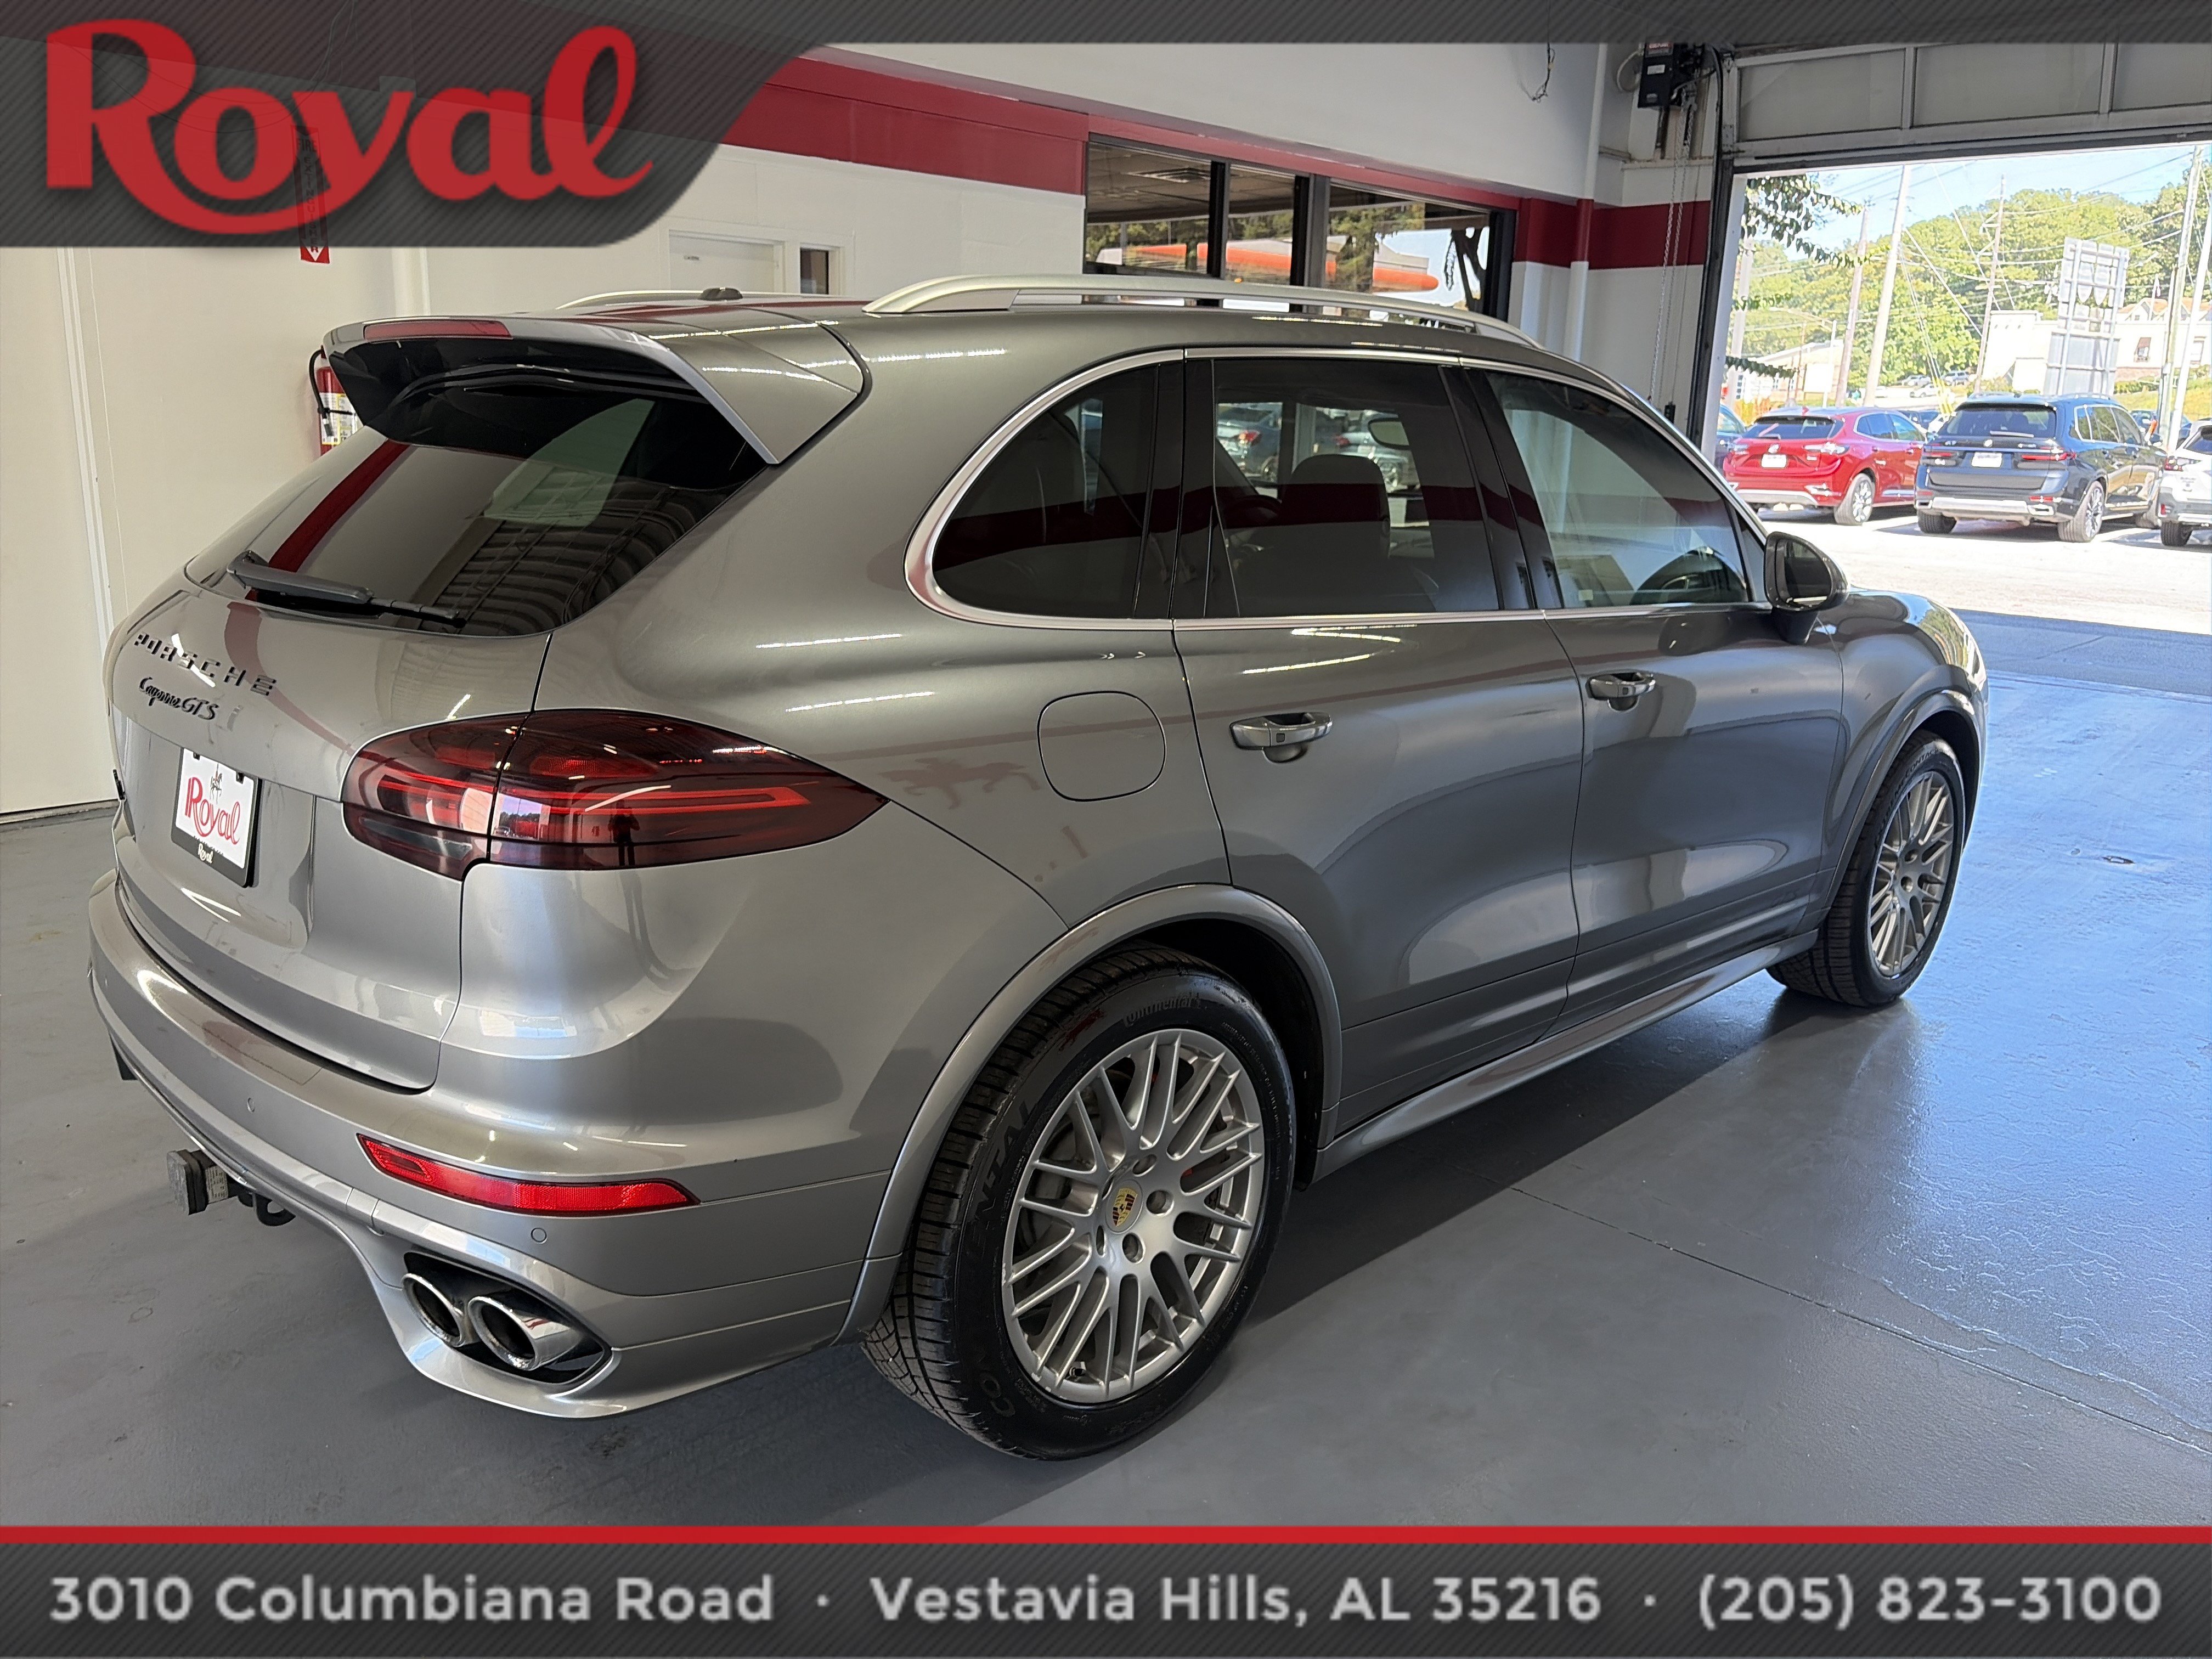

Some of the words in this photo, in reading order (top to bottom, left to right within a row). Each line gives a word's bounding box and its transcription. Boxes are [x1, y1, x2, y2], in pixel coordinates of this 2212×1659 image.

[296, 138, 318, 153] FIRE
[304, 156, 319, 253] EXTINGUISHER
[134, 633, 277, 697] PORSCHE
[139, 676, 182, 707] Cayenne
[182, 697, 219, 720] GTS
[184, 776, 240, 845] Royal
[198, 843, 214, 864] Royal
